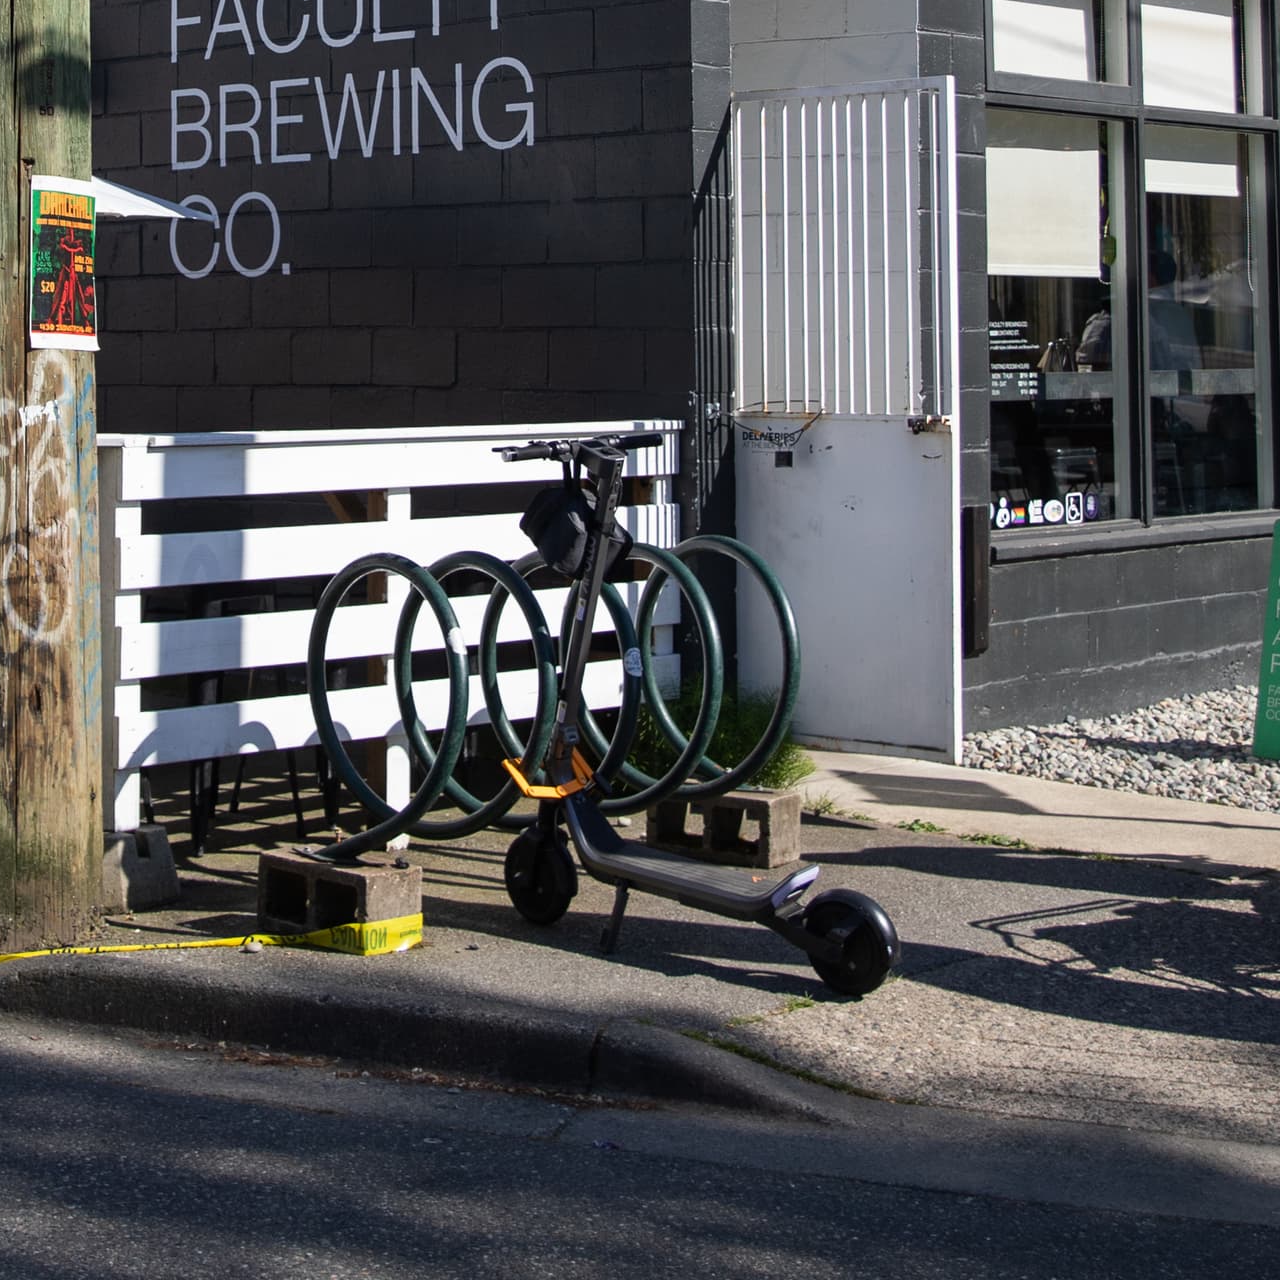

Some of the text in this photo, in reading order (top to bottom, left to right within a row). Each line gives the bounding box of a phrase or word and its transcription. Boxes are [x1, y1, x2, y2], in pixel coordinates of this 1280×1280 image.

[170, 56, 535, 172] BREWING
[169, 192, 291, 280] CO.
[40, 280, 56, 294] $20
